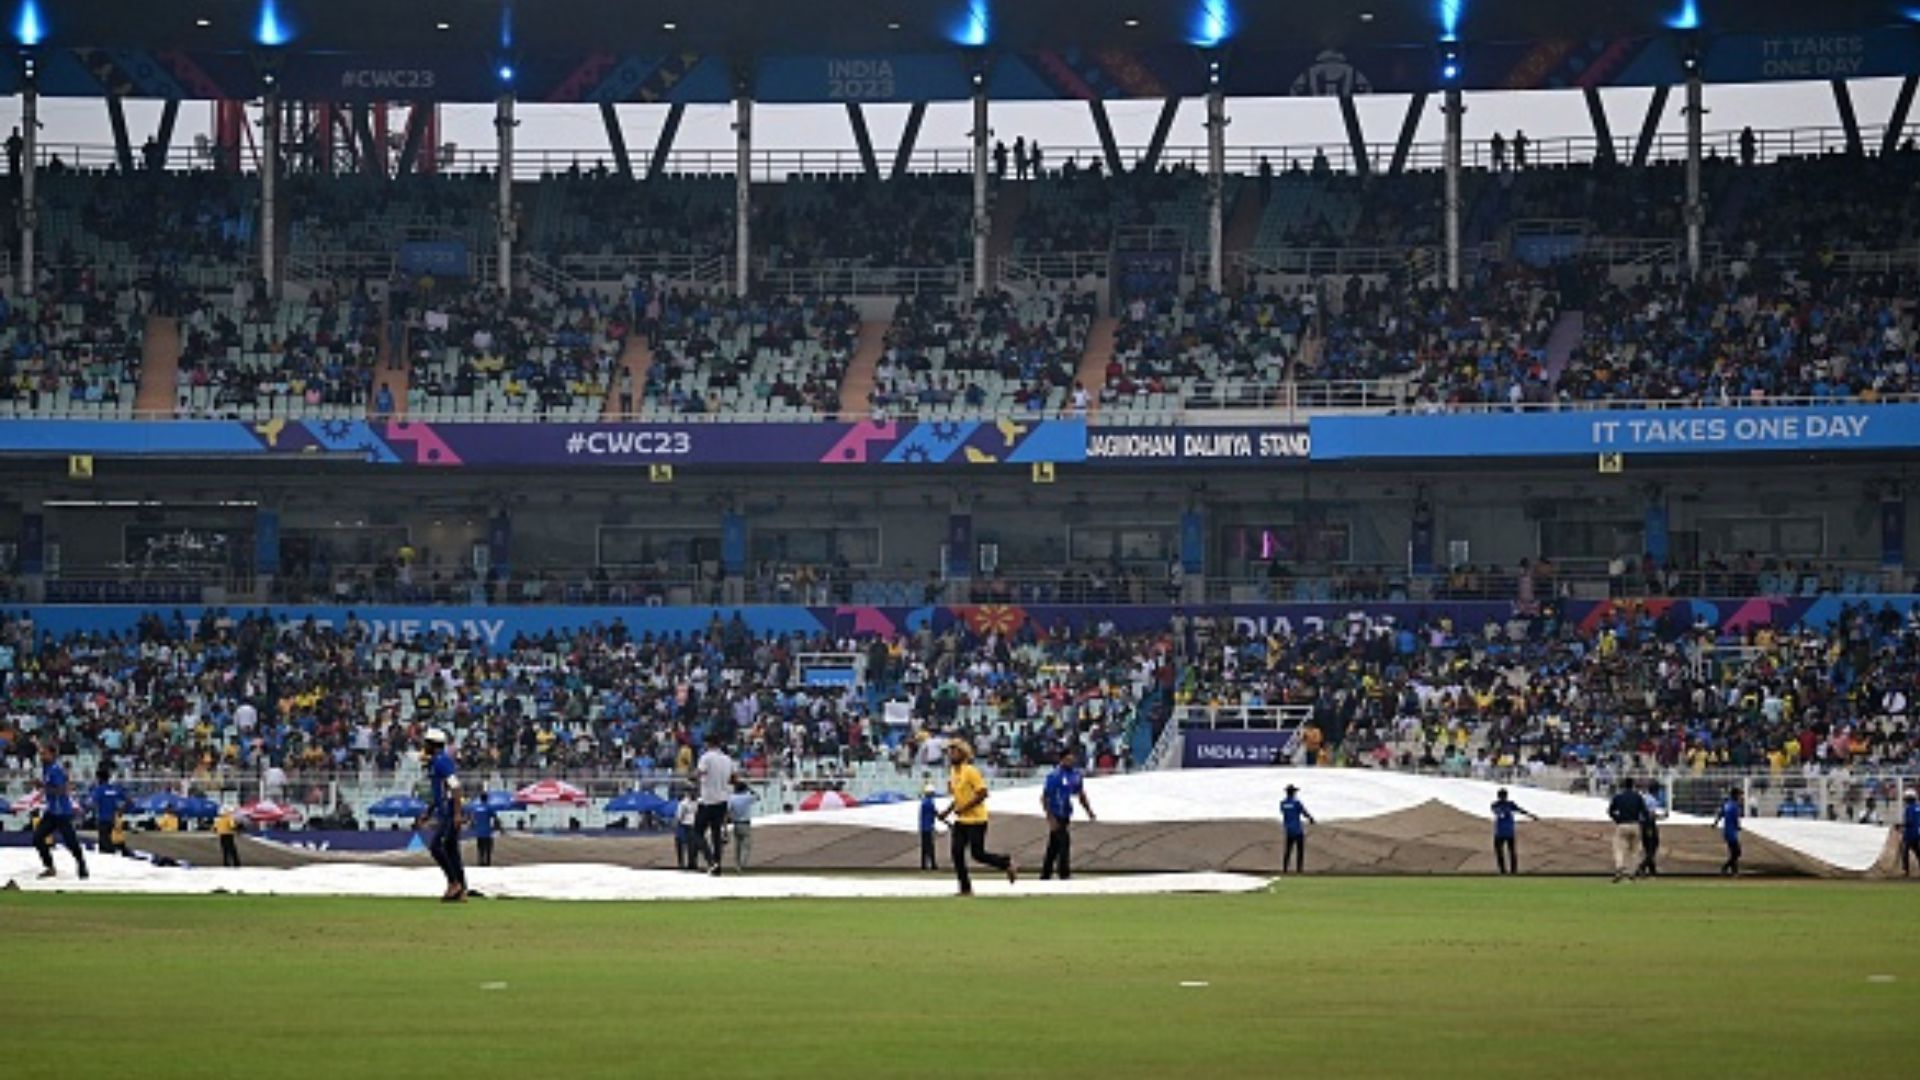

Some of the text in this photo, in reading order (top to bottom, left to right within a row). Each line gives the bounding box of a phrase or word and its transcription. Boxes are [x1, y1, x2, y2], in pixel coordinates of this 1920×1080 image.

[1763, 35, 1864, 56] IT TAKES
[828, 59, 893, 78] INDIA
[1763, 56, 1864, 76] ONE DAY
[342, 69, 435, 88] #CWC23
[829, 79, 895, 98] 2023
[1592, 414, 1868, 444] IT TAKES ONE DAY
[566, 432, 691, 454] #CWC23
[1260, 433, 1310, 457] STAND
[430, 618, 505, 645] DAY
[1197, 744, 1245, 759] INDIA
